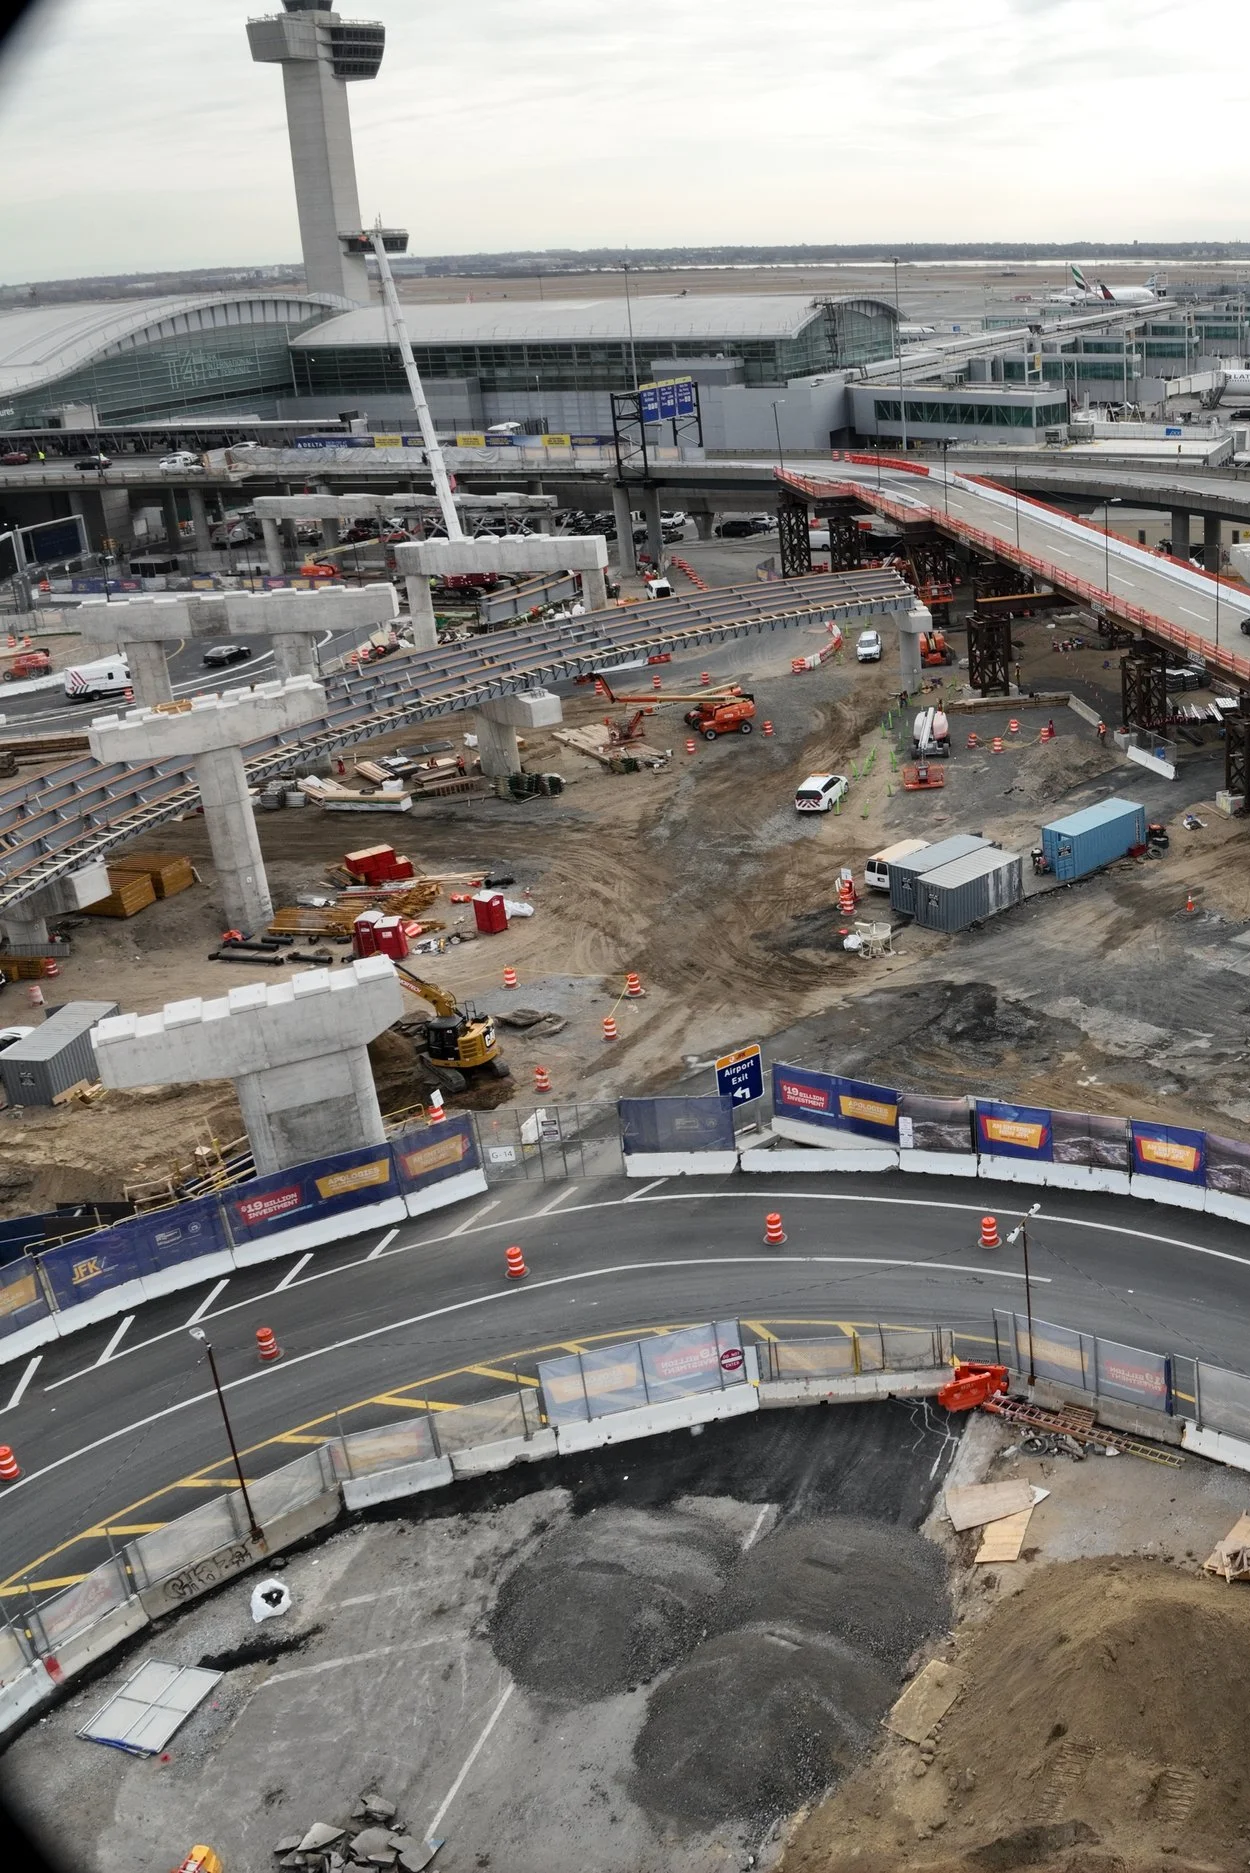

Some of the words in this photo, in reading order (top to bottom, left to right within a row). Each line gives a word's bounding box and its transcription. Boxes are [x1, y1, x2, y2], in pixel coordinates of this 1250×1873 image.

[724, 1060, 754, 1077] Airport
[731, 1073, 748, 1085] Exit
[786, 1094, 825, 1108] INVESTMENT
[799, 1091, 825, 1102] BILLION
[848, 1100, 889, 1115] APOLOGIES
[328, 1167, 381, 1187] APOLOGIES
[241, 1200, 264, 1214] $19
[264, 1192, 298, 1208] BILLION
[248, 1198, 299, 1219] INVESTMENT
[72, 1259, 103, 1281] JFK
